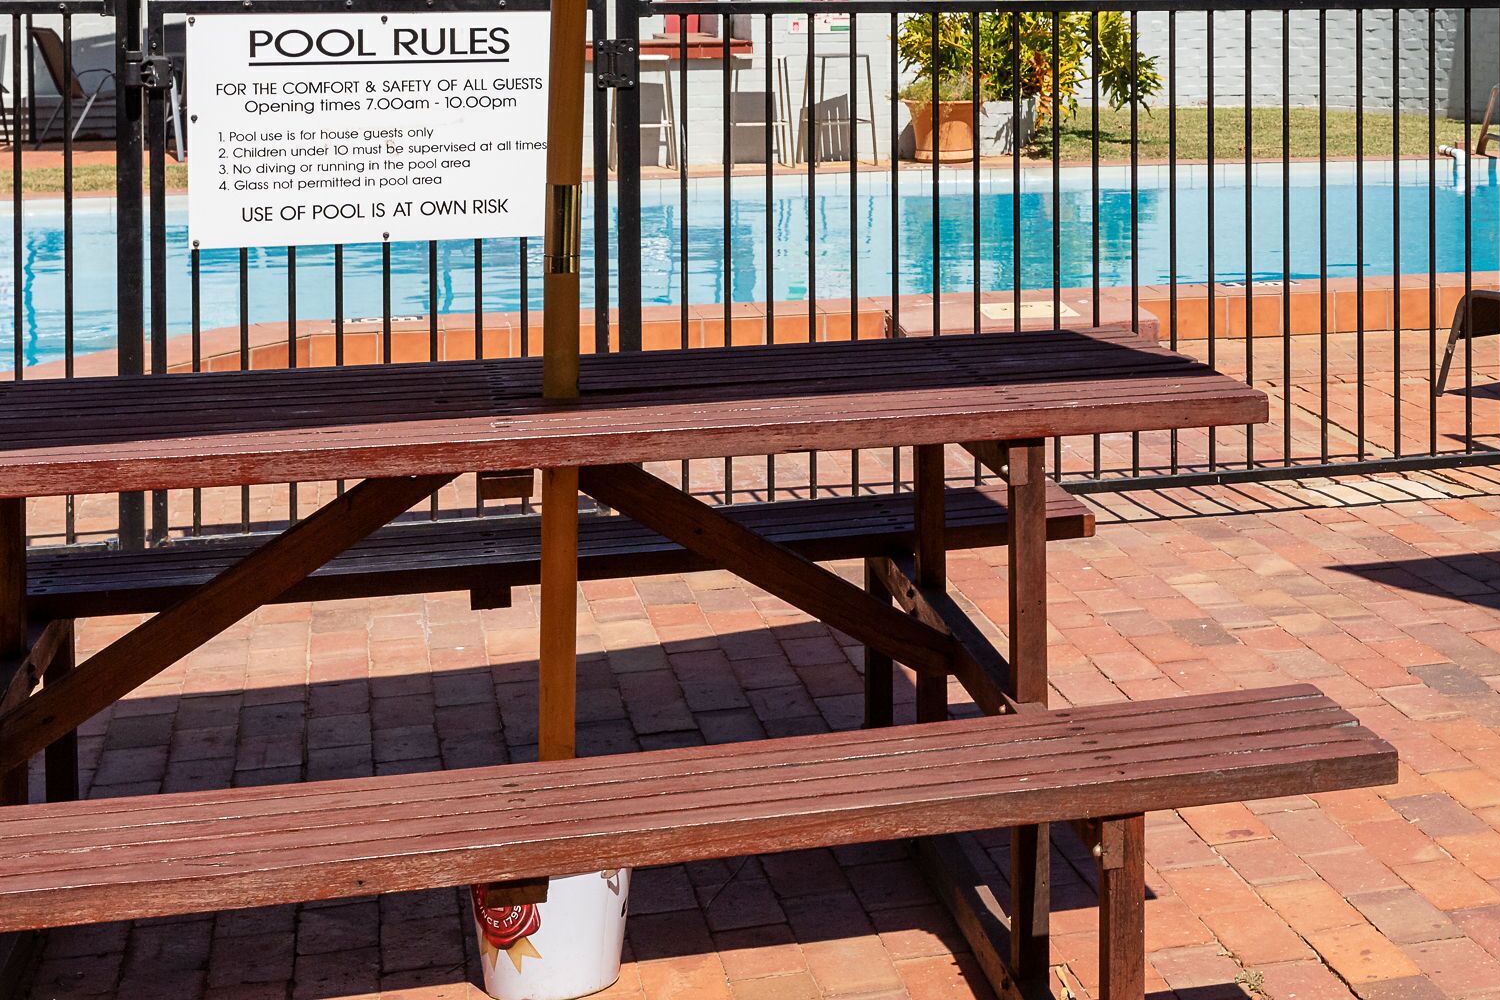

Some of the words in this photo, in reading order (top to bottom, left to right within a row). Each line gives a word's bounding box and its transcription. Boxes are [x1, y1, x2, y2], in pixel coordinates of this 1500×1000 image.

[250, 29, 376, 57] POOL
[394, 27, 510, 55] RULES
[217, 83, 246, 95] FOR
[253, 83, 276, 95] THE
[283, 81, 359, 94] COMFORT
[366, 81, 376, 92] &
[383, 80, 431, 92] SAFETY
[438, 80, 457, 91] OF
[464, 79, 487, 90] ALL
[493, 78, 542, 90] GUESTS
[245, 100, 314, 115] Opening
[320, 99, 360, 111] times
[366, 98, 429, 110] 7.00am
[445, 96, 516, 110] 10.00pm
[219, 132, 224, 141] 1.
[230, 132, 256, 141] Pool
[261, 133, 282, 141] use
[288, 131, 295, 140] is
[301, 130, 315, 140] for
[321, 130, 358, 139] house
[364, 128, 403, 140] guests
[408, 128, 433, 138] only
[219, 148, 228, 158] 2.
[233, 148, 286, 158] Children
[291, 146, 328, 156] under
[334, 145, 348, 155] 10
[353, 145, 381, 154] must
[387, 144, 403, 154] be
[409, 142, 475, 154] supervised
[480, 141, 492, 151] at
[497, 141, 511, 150] all
[515, 140, 547, 150] times
[219, 165, 228, 174] 3.
[234, 165, 251, 174] No
[256, 163, 295, 175] diving
[318, 161, 364, 173] running
[369, 161, 379, 170] in
[384, 160, 403, 169] the
[409, 159, 436, 171] pool
[441, 160, 470, 168] area
[219, 181, 229, 190] 4.
[234, 180, 268, 190] Glass
[274, 179, 293, 189] not
[298, 177, 360, 190] permitted
[365, 177, 375, 186] in
[380, 176, 407, 188] pool
[413, 177, 441, 185] area
[242, 207, 272, 222] USE
[280, 206, 305, 220] OF
[313, 204, 365, 219] POOL
[372, 203, 385, 217] IS
[393, 202, 412, 216] AT
[420, 200, 466, 216] OWN
[473, 199, 508, 214] RISK
[503, 905, 522, 928] 1795
